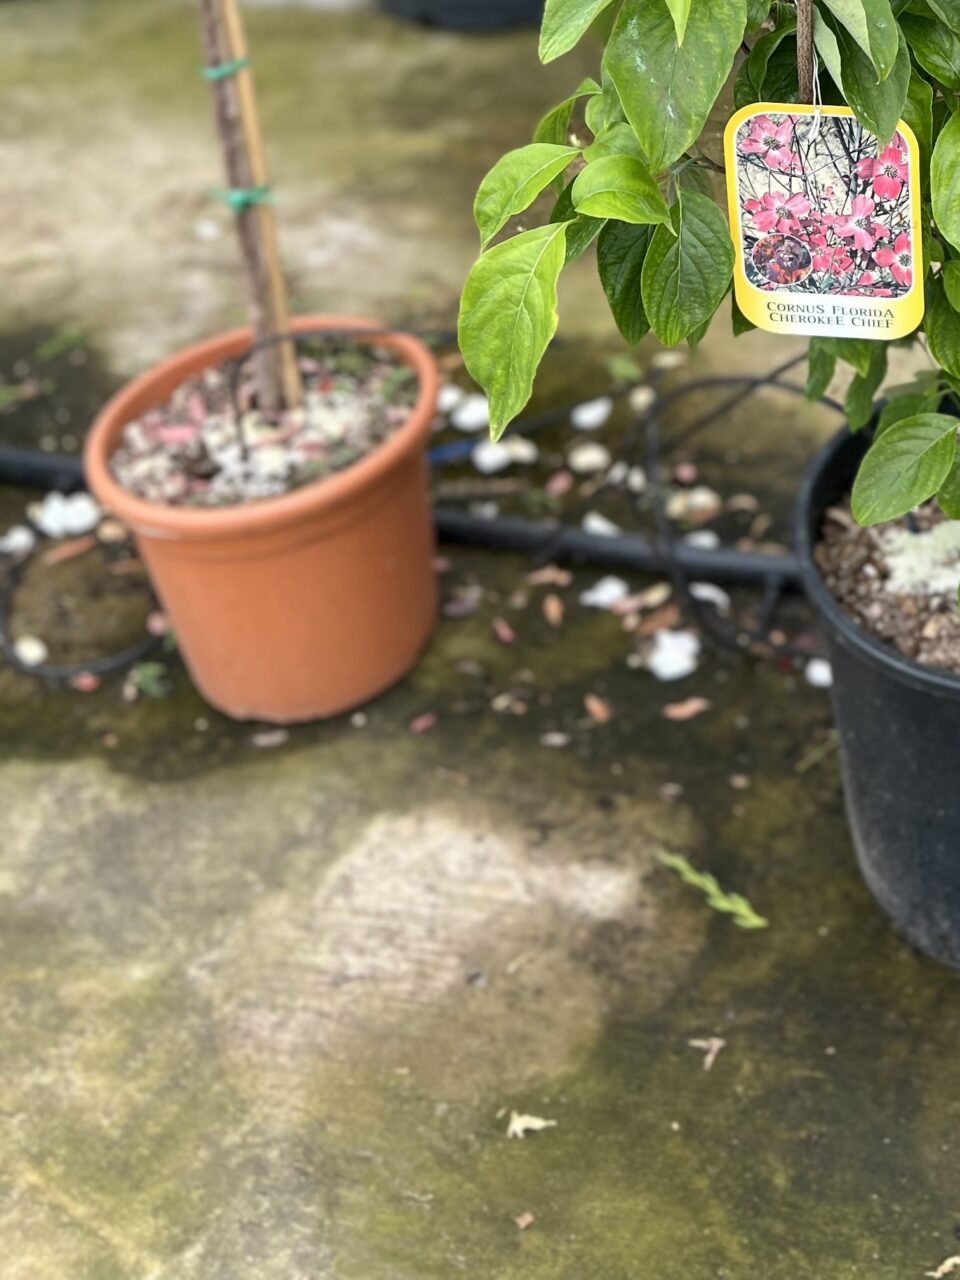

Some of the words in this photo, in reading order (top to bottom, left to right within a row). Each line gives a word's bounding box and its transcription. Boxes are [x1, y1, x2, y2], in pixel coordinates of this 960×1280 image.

[767, 301, 825, 314] CORNUS
[832, 305, 894, 318] FLORIDA
[769, 312, 844, 326] CHEROKEE
[851, 317, 893, 328] CHIEF
